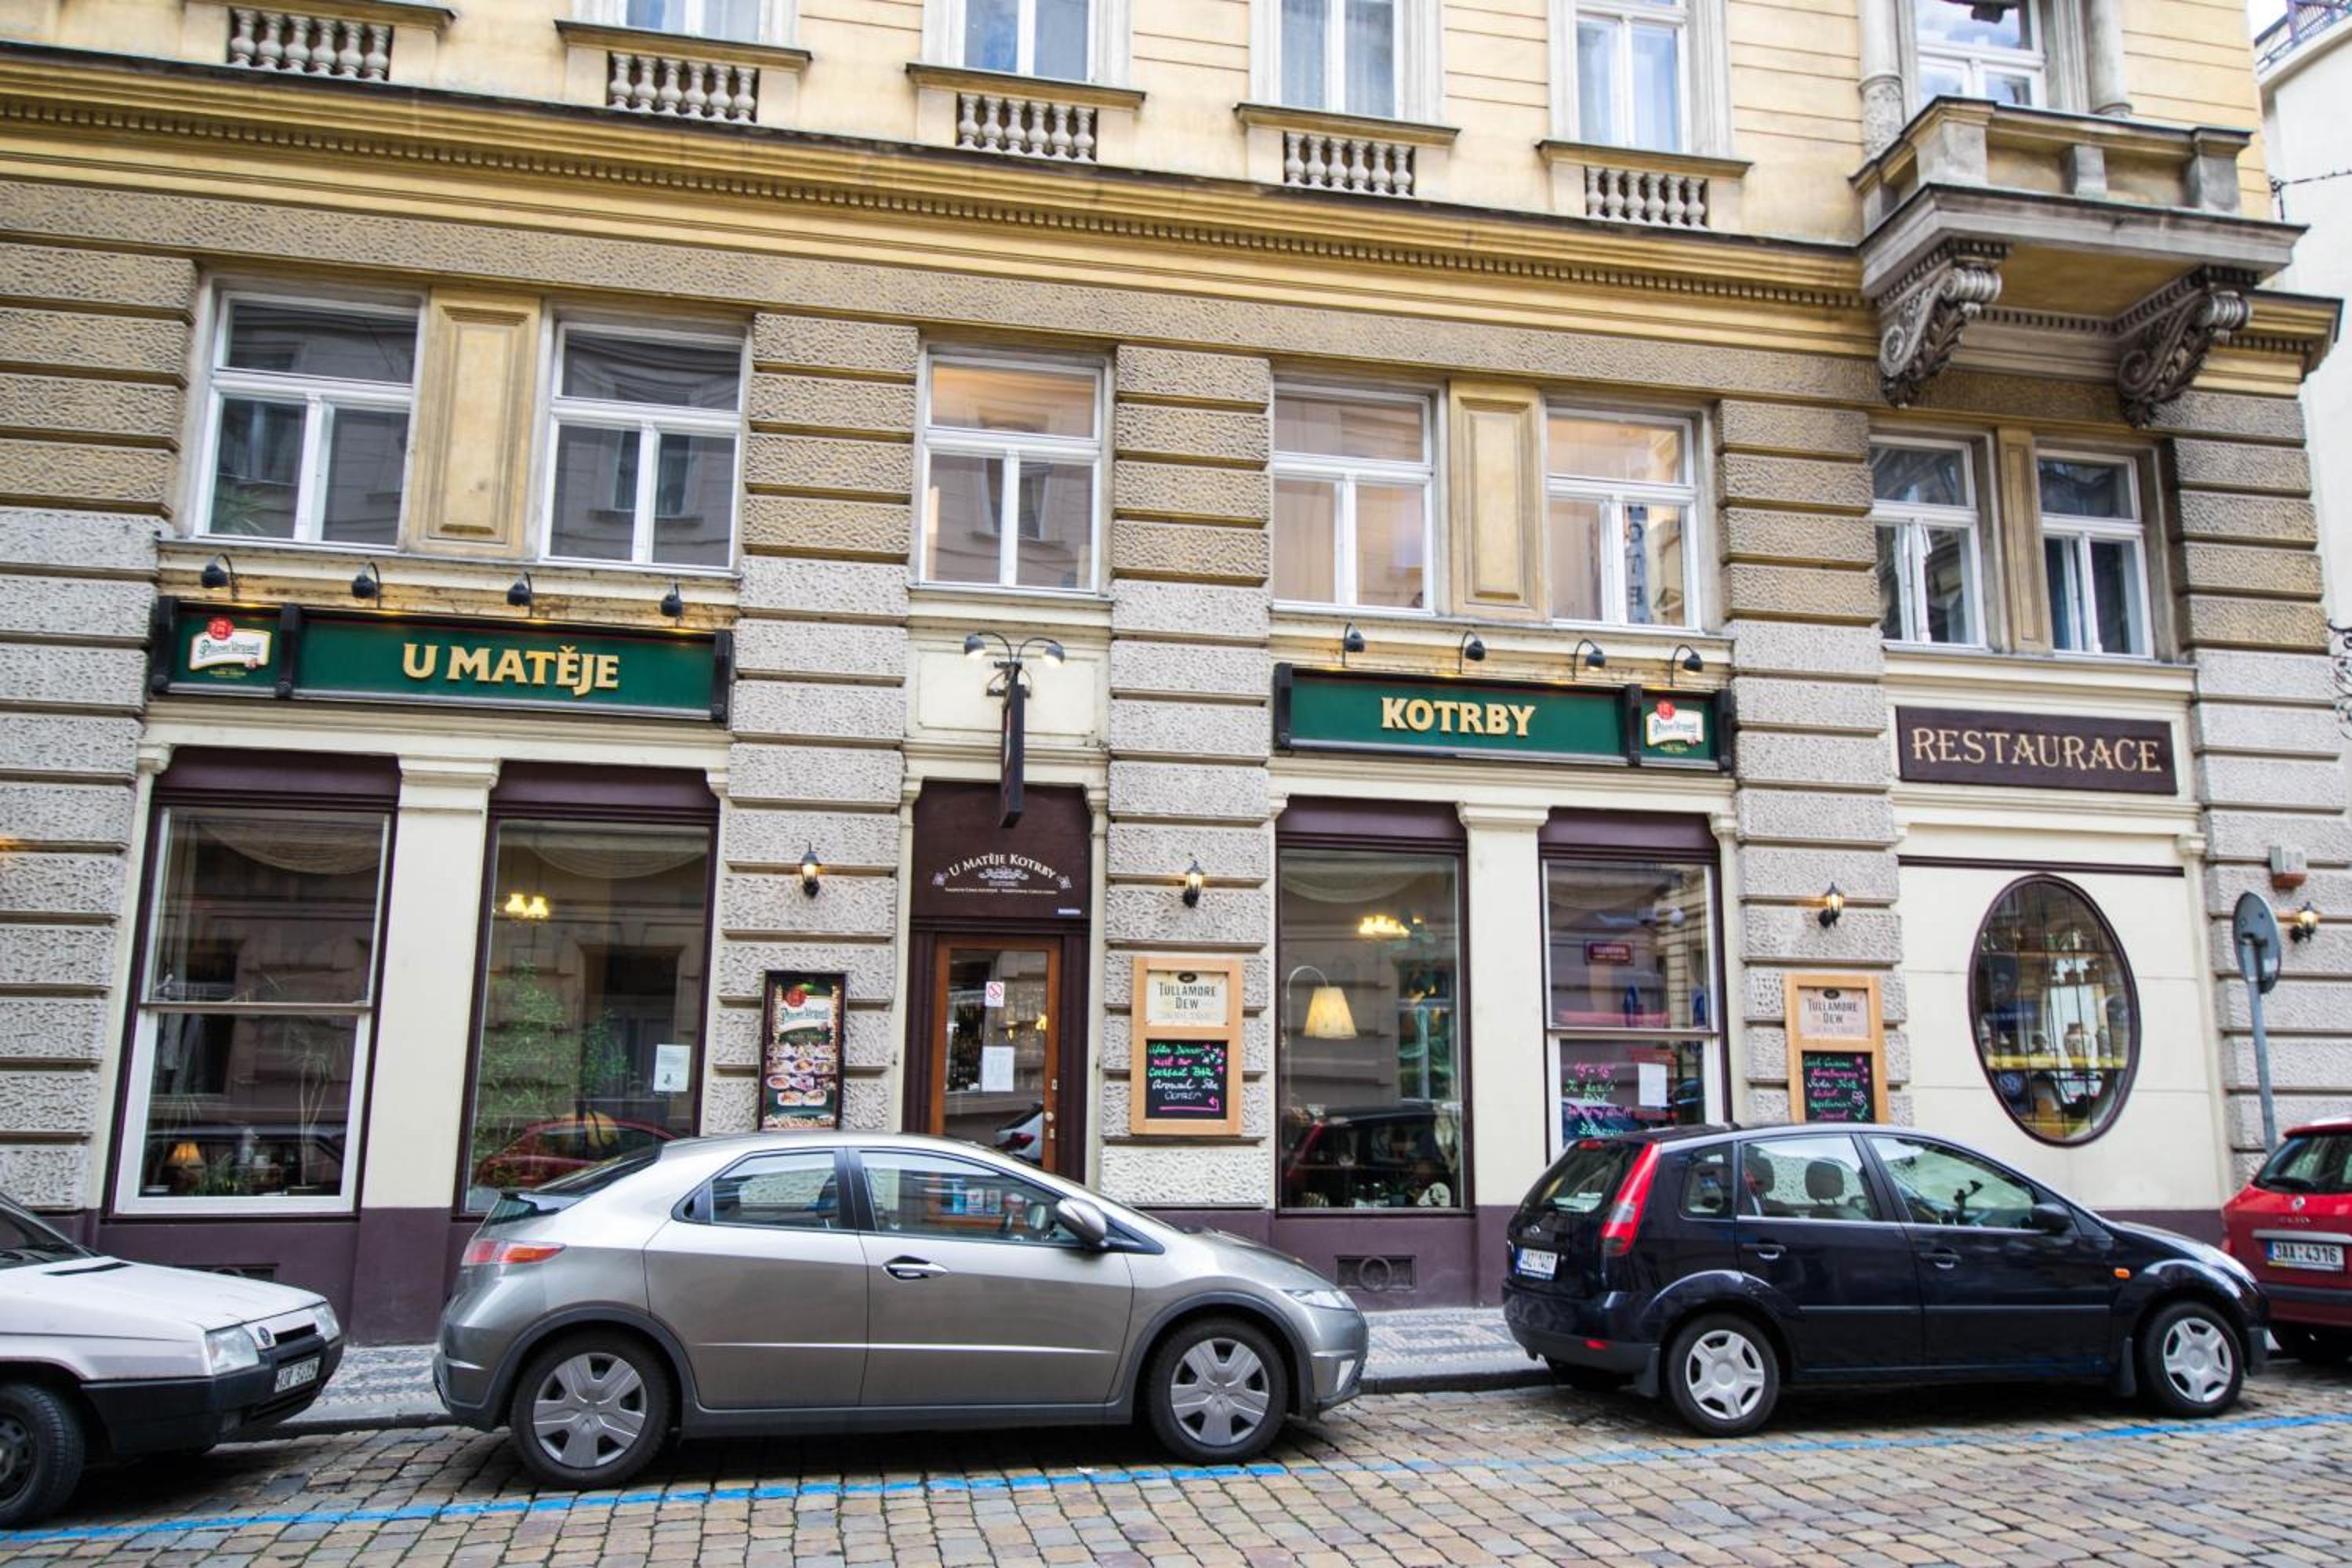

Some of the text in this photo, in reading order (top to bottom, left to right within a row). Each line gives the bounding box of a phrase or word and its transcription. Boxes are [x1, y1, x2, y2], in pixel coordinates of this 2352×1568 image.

[403, 643, 619, 696] U MATĚJE
[1381, 696, 1537, 736] KOTRBY
[1911, 728, 2162, 772] RESTAURACE
[948, 852, 1058, 879] U MATĚJE KOTRBY
[1157, 982, 1217, 998] TULLAMORE
[2275, 1244, 2338, 1263] 3AA 4316
